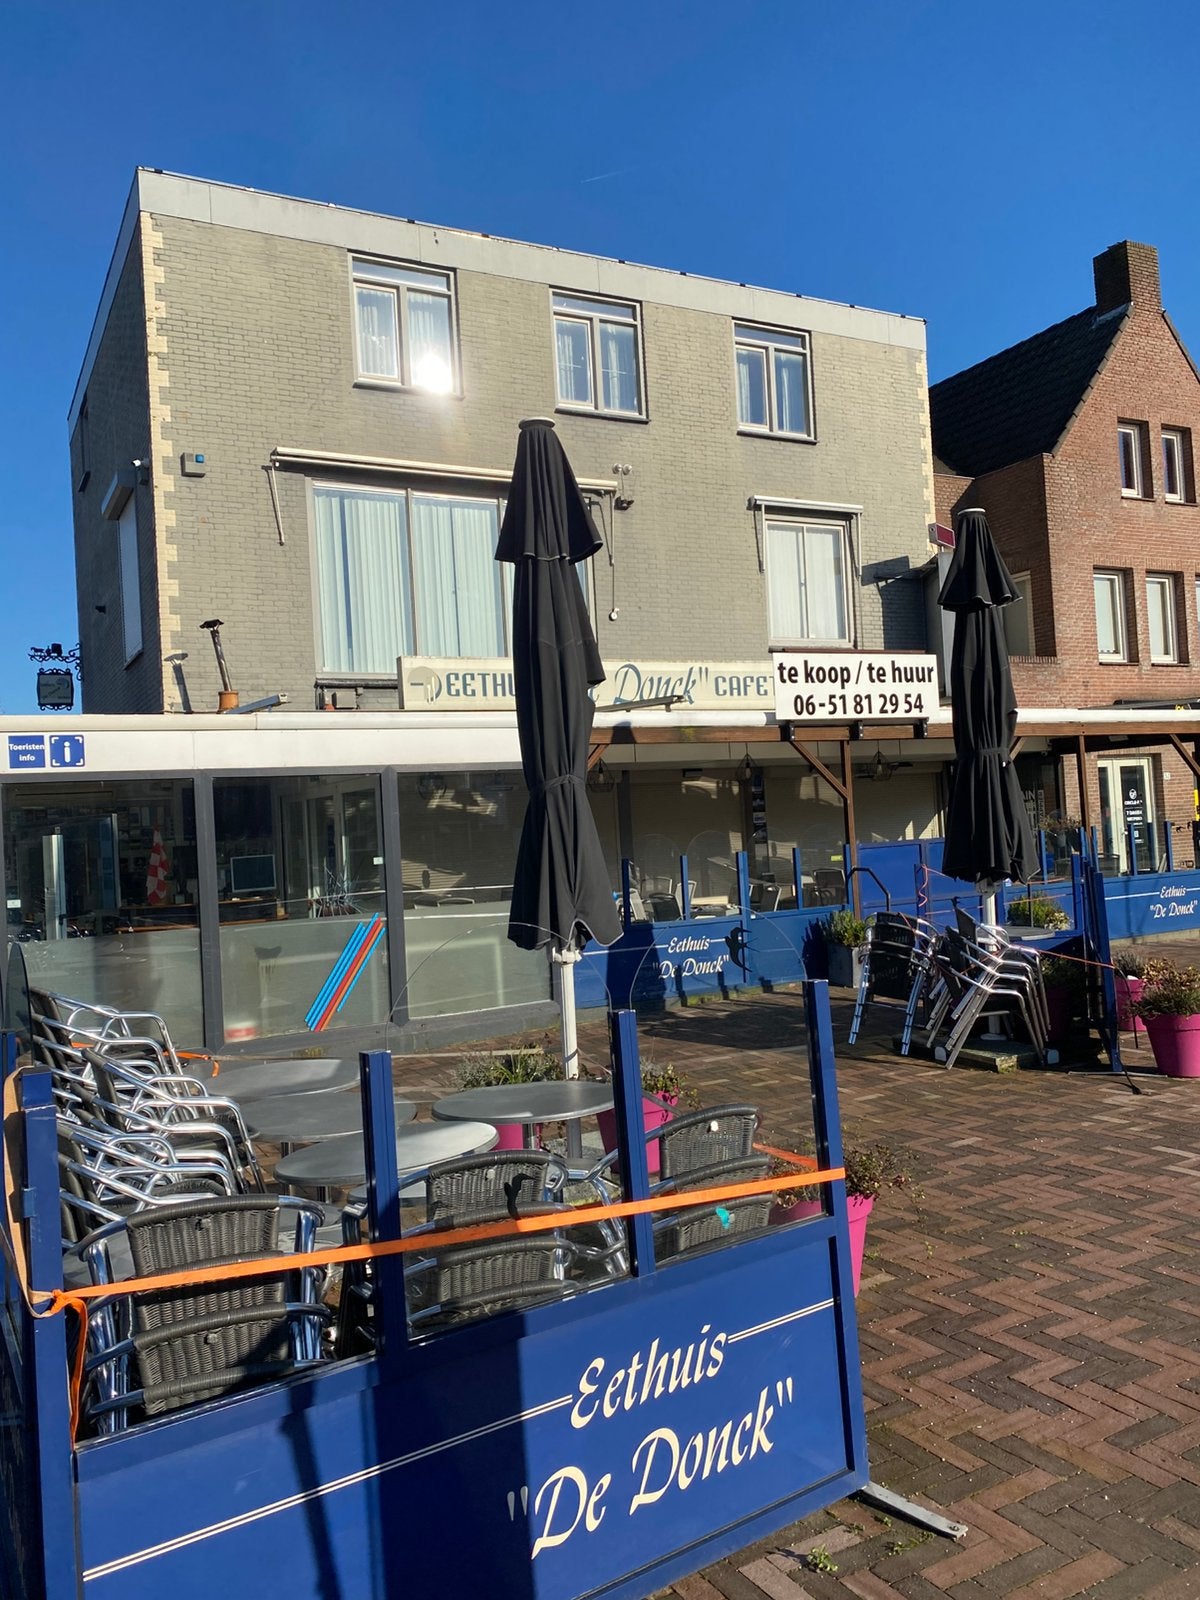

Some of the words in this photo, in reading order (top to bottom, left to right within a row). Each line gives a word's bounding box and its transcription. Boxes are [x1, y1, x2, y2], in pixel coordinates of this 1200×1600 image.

[778, 662, 799, 684] te
[804, 660, 851, 689] koop
[855, 660, 863, 684] /
[867, 663, 887, 683] te
[891, 660, 934, 683] huur
[793, 694, 847, 716] 06-51
[853, 693, 873, 714] 81
[878, 693, 899, 714] 29
[904, 693, 924, 713] 54
[9, 743, 45, 751] Toeristen
[667, 935, 711, 954] Eethuis
[570, 1323, 728, 1429] Eethuis
[506, 1465, 612, 1560] "De
[629, 1376, 794, 1516] Donck"
